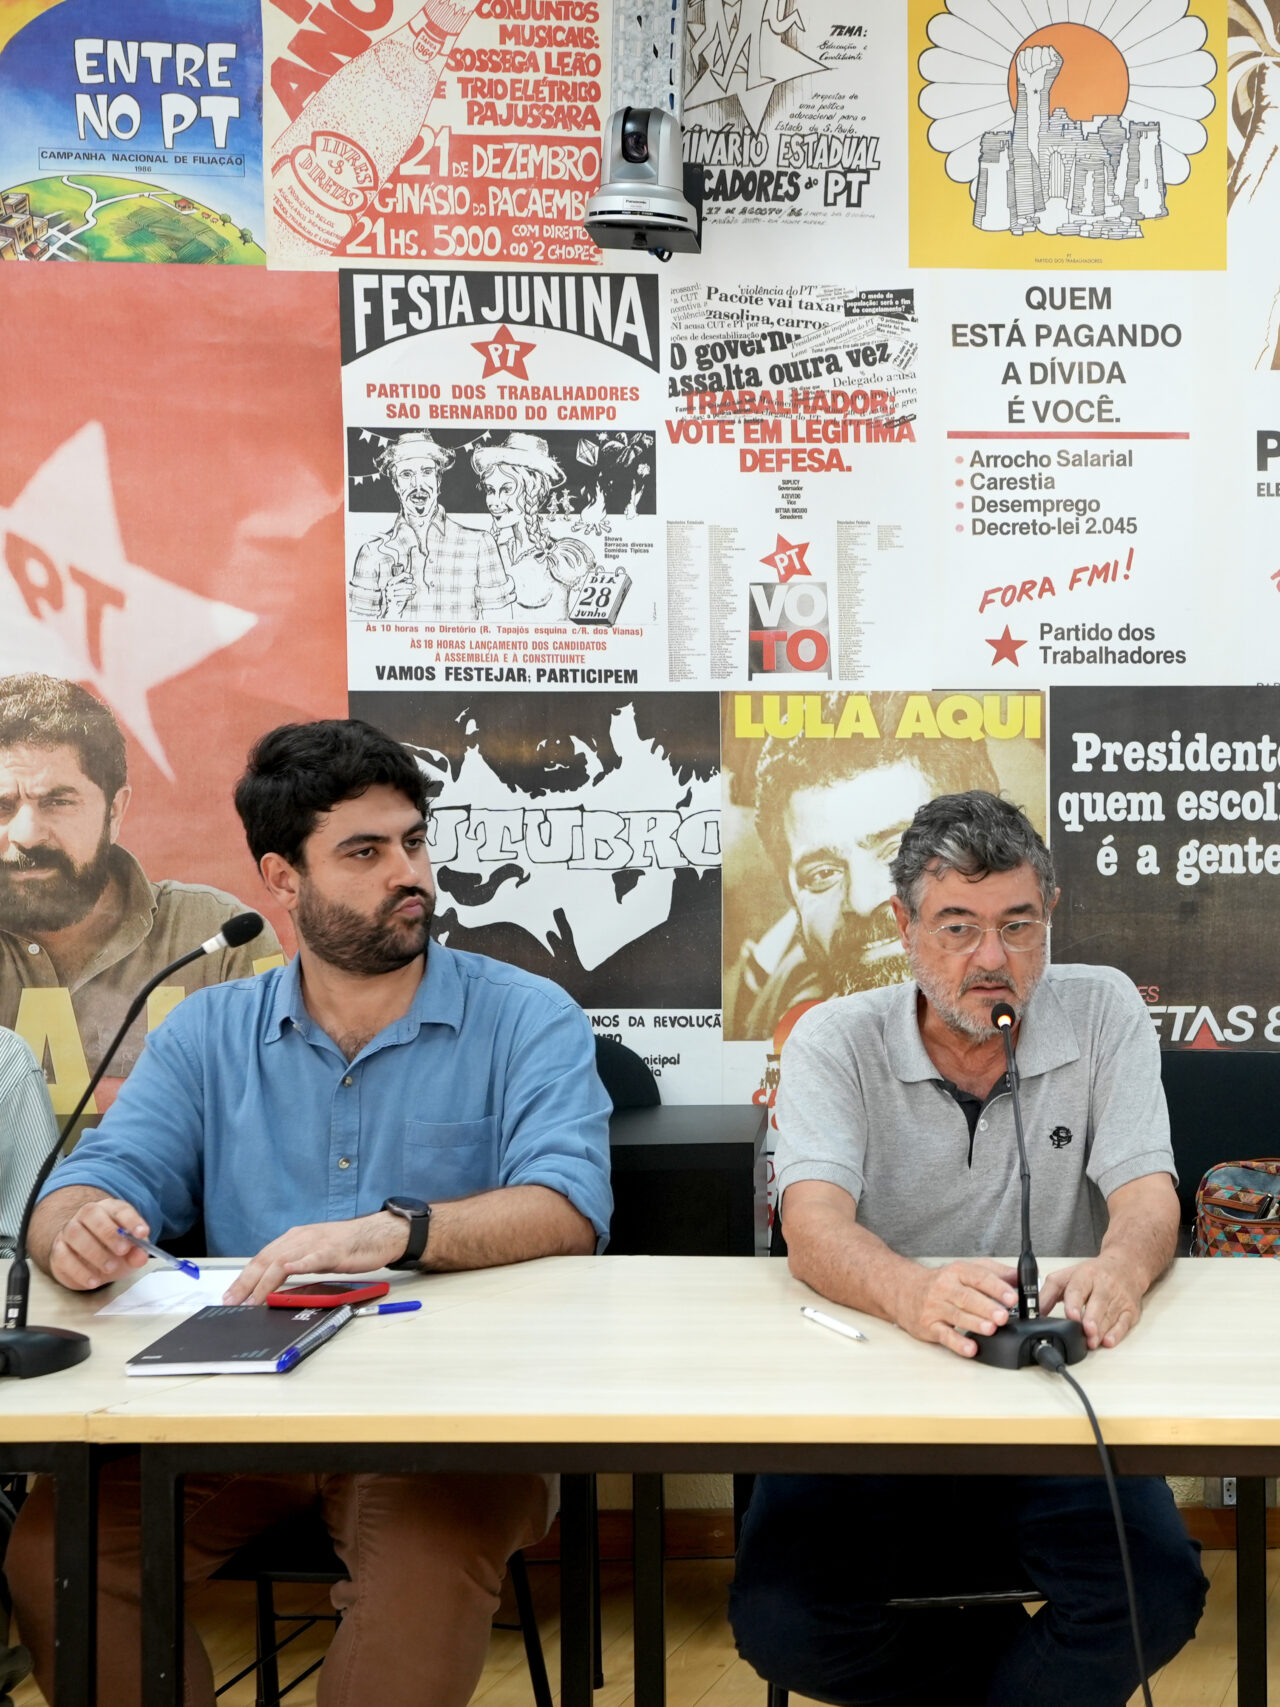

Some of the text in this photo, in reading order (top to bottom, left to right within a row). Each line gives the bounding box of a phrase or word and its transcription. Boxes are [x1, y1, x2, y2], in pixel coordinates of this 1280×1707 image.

[474, 0, 600, 23] CONJUNTOS
[500, 24, 600, 49] MUSICAIS:
[830, 24, 868, 37] TEMA:
[74, 38, 238, 88] ENTRE
[446, 48, 601, 77] SOSSEGA LEÃO
[457, 75, 601, 103] TRIO ELÉTRICO
[75, 93, 240, 149] NO PT
[466, 102, 600, 132] PAJUSSARA
[41, 151, 243, 167] CAMPANHA NACIONAL DE FILIAÇÃO
[399, 125, 600, 184] 21 DE DEZEMBRO
[777, 132, 881, 170] ESTADUAL
[135, 165, 152, 173] 1986
[374, 183, 470, 216] GINÁSIO
[824, 169, 871, 208] PT
[346, 217, 427, 256] 21 HS.
[706, 286, 764, 306] Pacote
[767, 294, 794, 309] vai
[1025, 286, 1113, 311] QUEM
[352, 274, 654, 362] FESTA JUNINA
[951, 318, 1182, 348] ESTÁ PAGANDO
[488, 343, 521, 368] PT
[768, 342, 893, 384] outra vez
[1001, 357, 1127, 385] A DÍVIDA
[366, 383, 640, 402] PARTIDO DOS TRABALHADORES
[681, 389, 896, 415] TRABALHADOR:
[386, 402, 617, 421] SÃO BERNARDO DO CAMPO
[1007, 394, 1121, 424] É VOCÊ.
[665, 412, 917, 444] VOTE EM LEGÍTIMA
[739, 448, 852, 473] DEFESA.
[969, 449, 1133, 468] Arrocho Salarial
[969, 472, 1056, 490] Carestia
[971, 495, 1101, 517] Desemprego
[971, 516, 1138, 536] Decreto-lei 2.045
[774, 547, 802, 576] PT
[978, 546, 1135, 614] FORA FMI!
[578, 586, 612, 608] 28
[573, 608, 607, 620] junho
[438, 623, 568, 637] Diretório esquina
[1039, 622, 1156, 642] Partido dos
[436, 639, 607, 651] HORAS CANDIDATOS
[444, 651, 586, 664] ASSEMBLÉIA CONSTITUINTE
[1038, 646, 1187, 665] Trabalhadores
[375, 665, 639, 685] VAMOS PARTICIPEM
[734, 694, 1041, 743] LULA AQUI
[1058, 790, 1166, 832] quem
[1096, 834, 1118, 876] é
[1136, 844, 1160, 875] a
[628, 1015, 646, 1028] DA
